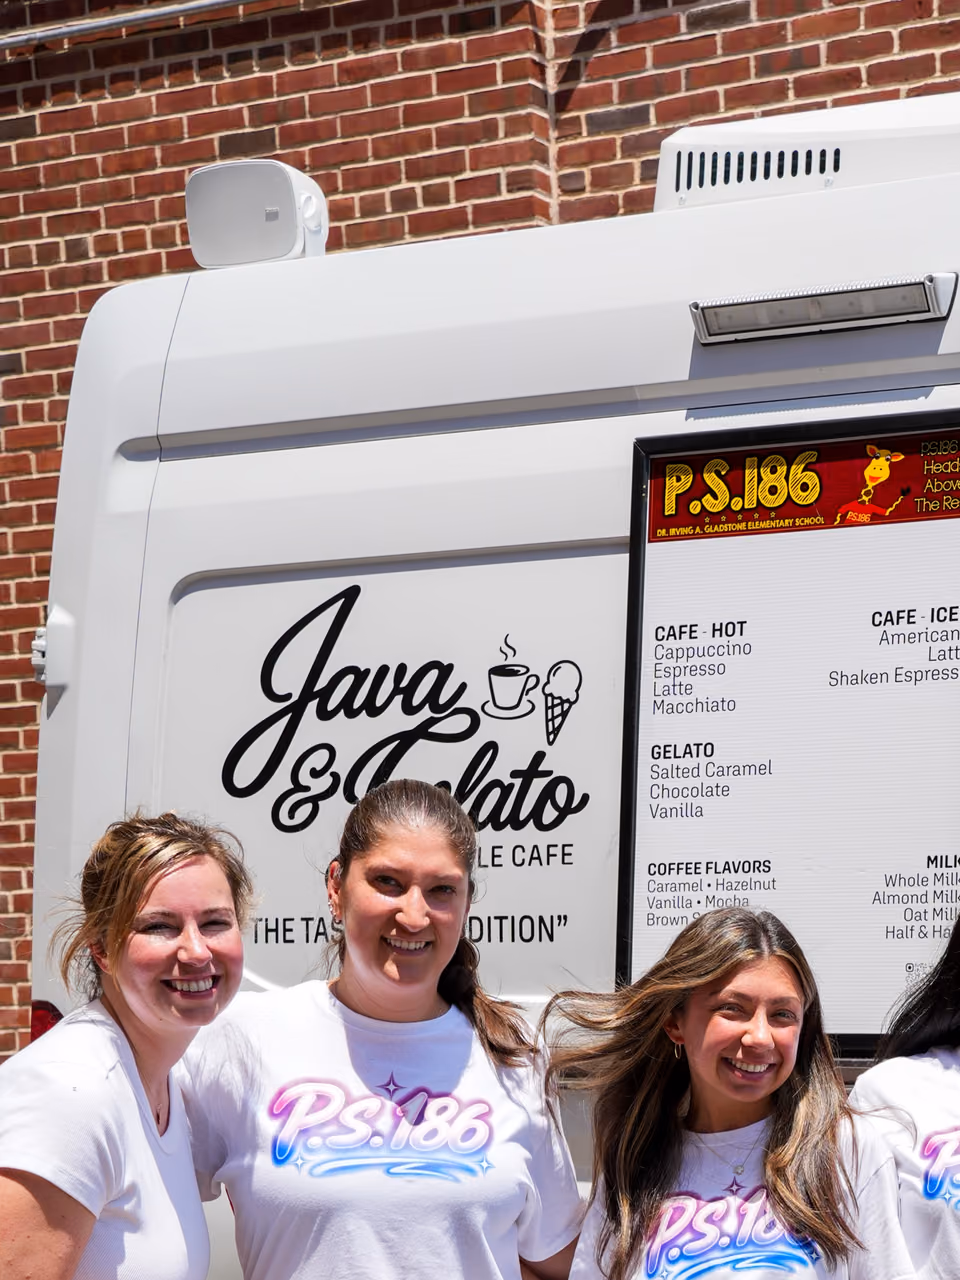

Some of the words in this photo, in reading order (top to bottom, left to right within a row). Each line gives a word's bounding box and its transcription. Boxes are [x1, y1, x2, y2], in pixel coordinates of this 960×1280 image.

[664, 451, 820, 515] P.S.186
[914, 498, 940, 512] The
[656, 527, 669, 537] DR.
[669, 526, 694, 537] IRVING
[695, 525, 703, 534] A.
[704, 522, 747, 533] GLADSTONE
[747, 518, 794, 529] ELEMENTARY
[795, 516, 825, 526] SCHOOL
[871, 609, 916, 627] CAFE
[655, 624, 699, 642] CAFE
[711, 621, 748, 638] HOT
[654, 642, 752, 663] Cappuccino
[654, 662, 726, 681] Espresso
[829, 669, 889, 687] Shaken
[221, 584, 468, 798] Java
[653, 680, 693, 697] Latte
[652, 697, 737, 715] Macchiato
[651, 742, 715, 760] GELATO
[271, 743, 341, 833] &
[343, 707, 590, 832] Glato
[650, 762, 701, 780] Salted
[705, 760, 773, 779] Caramel
[650, 782, 730, 800] Chocolate
[649, 803, 704, 819] Vanilla
[512, 843, 574, 868] CAFE
[648, 861, 702, 876] COFFEE
[705, 860, 771, 875] FLAVORS
[647, 878, 703, 893] Caramel
[716, 877, 777, 891] Hazelnut
[884, 873, 929, 887] Whole
[647, 896, 693, 909] Vanilla
[705, 894, 749, 908] Mocha
[872, 890, 928, 904] Almond
[647, 912, 689, 926] Brown
[903, 907, 929, 922] Oat
[885, 925, 915, 939] Half
[917, 925, 929, 939] &
[932, 925, 952, 939] Ha
[269, 1078, 494, 1165] P.S.186
[645, 1186, 808, 1279] P.S.18
